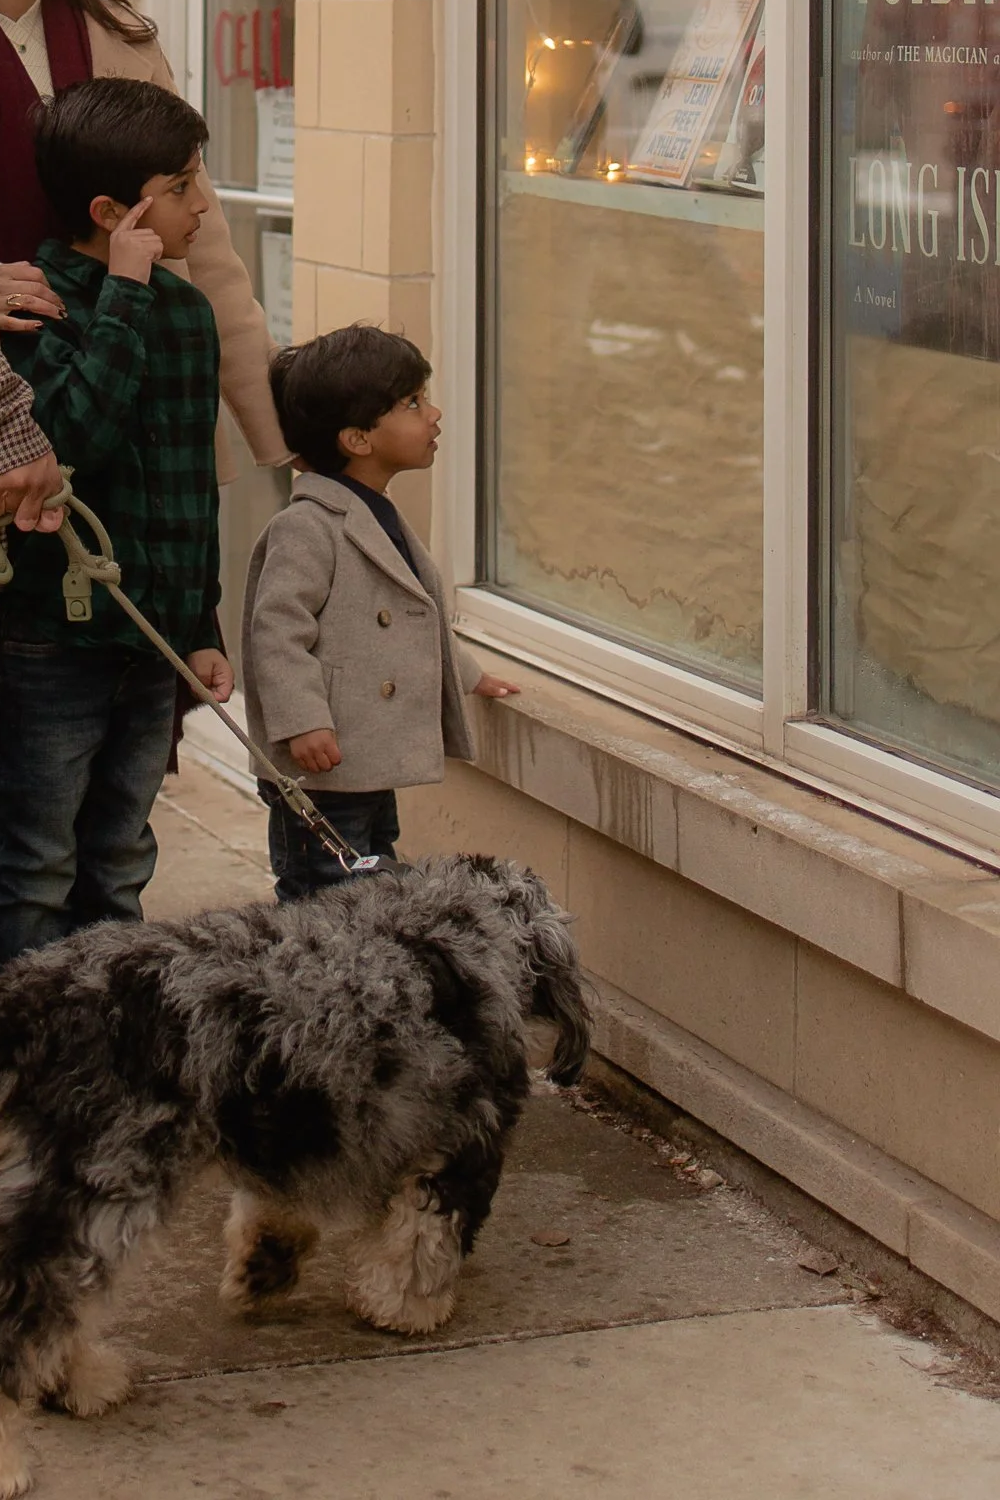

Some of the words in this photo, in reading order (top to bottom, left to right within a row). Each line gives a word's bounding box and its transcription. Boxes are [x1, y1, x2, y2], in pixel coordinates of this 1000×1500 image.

[214, 6, 293, 91] CELL
[850, 43, 882, 62] author
[884, 45, 895, 65] of
[897, 45, 921, 62] THE
[925, 46, 989, 65] MAGICIAN
[689, 55, 726, 80] BILLIE
[684, 83, 715, 106] JEAN
[646, 133, 693, 160] ATHLETE
[849, 156, 940, 258] LONG
[854, 285, 862, 303] A
[866, 286, 897, 309] Novel
